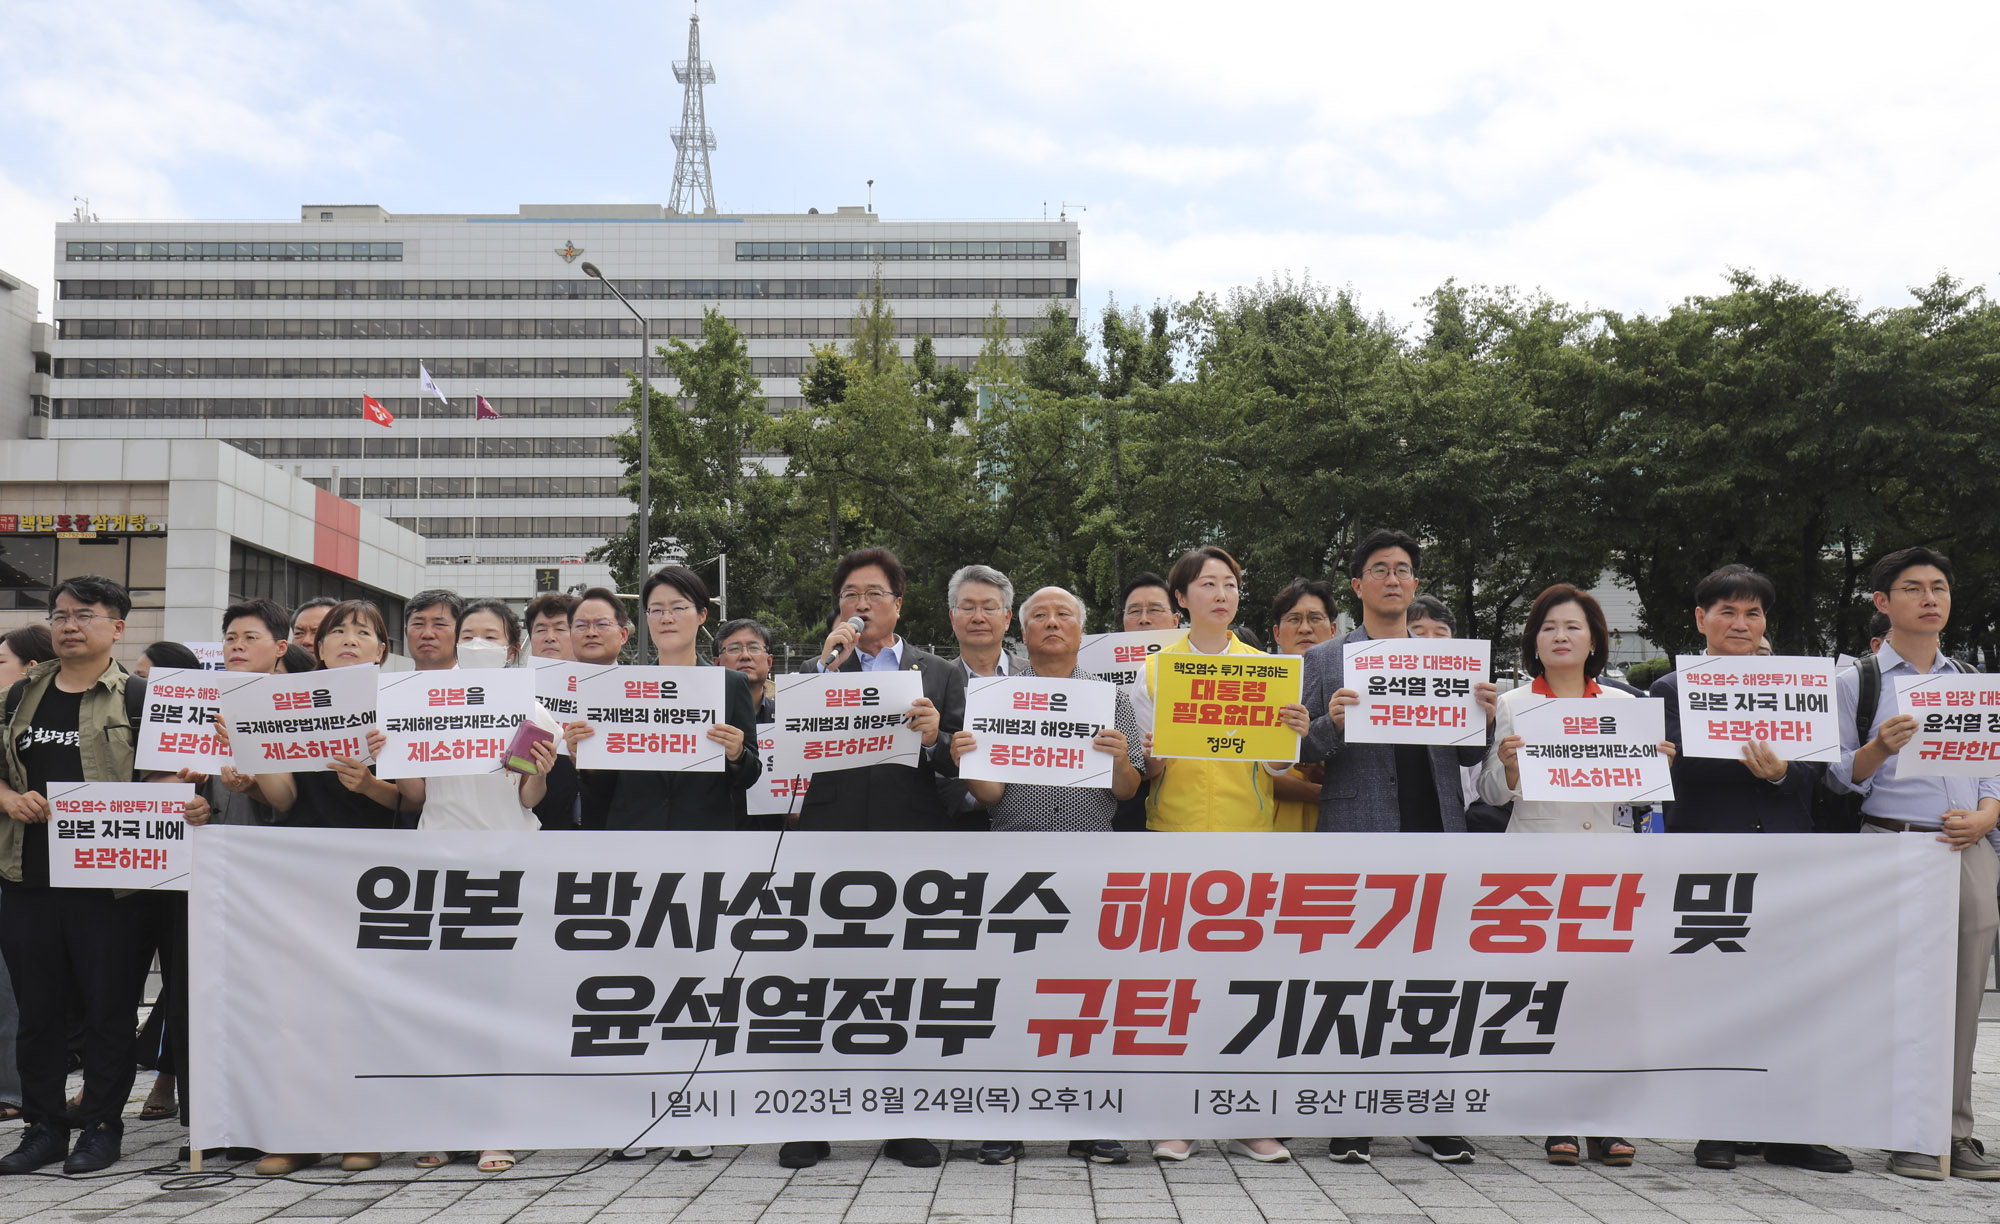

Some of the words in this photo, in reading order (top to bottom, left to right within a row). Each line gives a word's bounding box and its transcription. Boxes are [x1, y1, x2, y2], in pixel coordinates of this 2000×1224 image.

[1174, 662, 1218, 675] 핵오염수
[1221, 665, 1243, 676] 투기
[1246, 666, 1288, 678] 구경하는
[1354, 655, 1384, 670] 일본
[1388, 655, 1419, 669] 입장
[1423, 655, 1481, 671] 대변하는
[624, 681, 678, 699] 일본은
[1368, 676, 1426, 696] 윤석열
[1432, 677, 1470, 697] 정부
[1686, 673, 1739, 686] 핵오염수
[1743, 674, 1797, 686] 해양투기
[1801, 674, 1828, 687] 말고
[153, 685, 195, 699] 핵오염수
[197, 687, 220, 700] 해양
[272, 688, 332, 710] 일본을
[428, 686, 485, 706] 일본을
[825, 687, 880, 707] 일본은
[1190, 679, 1267, 702] 대통령
[1909, 691, 1942, 706] 일본
[1945, 691, 1976, 706] 입장
[1012, 691, 1068, 712] 일본은
[1688, 692, 1728, 711] 일본
[1734, 693, 1778, 711] 자국
[1784, 693, 1828, 713] 내에
[150, 703, 183, 723] 일본
[236, 710, 376, 734] 국제해양법재판소에
[386, 713, 526, 733] 국제해양법재판소에
[587, 708, 649, 723] 국제범죄
[653, 708, 716, 725] 해양투기
[1172, 702, 1287, 727] 필요없다!
[1370, 705, 1466, 727] 규탄한다!
[1923, 713, 1982, 733] 윤석열
[785, 716, 849, 733] 국제범죄
[972, 717, 1036, 736] 국제범죄
[1562, 716, 1617, 734] 일본을
[1708, 720, 1812, 742] 보관하라!
[261, 737, 359, 760] 제소하라!
[408, 738, 504, 762] 제소하라!
[606, 732, 696, 754] 중단하라!
[803, 735, 894, 760] 중단하라!
[1207, 737, 1246, 753] 정의당
[1526, 744, 1658, 758] 국제해양법재판소에
[989, 744, 1084, 769] 중단하라!
[1548, 768, 1642, 787] 제소하라!
[56, 800, 106, 813] 핵오염수
[110, 800, 158, 813] 해양투기
[161, 801, 185, 813] 말고
[57, 820, 95, 839] 일본
[101, 820, 140, 839] 자국
[146, 820, 184, 840] 내에
[74, 848, 167, 870] 보관하라!
[356, 866, 525, 951] 일본
[553, 870, 1071, 953] 방사성오염수
[1097, 870, 1447, 953] 해양투기
[1469, 873, 1646, 953] 중단
[1670, 873, 1759, 954] 및
[570, 975, 1000, 1057] 윤석열정부
[1027, 979, 1201, 1057] 규탄
[1218, 980, 1569, 1059] 기자회견
[667, 1089, 718, 1118] 일시
[754, 1088, 852, 1114] 2023년
[861, 1087, 904, 1114] 8월
[913, 1086, 1020, 1113] 24일(목)
[1028, 1087, 1123, 1114] 오후1시
[1209, 1089, 1261, 1115] 장소
[1295, 1089, 1347, 1115] 용산
[1355, 1089, 1455, 1114] 대통령실
[1464, 1088, 1490, 1113] 앞
